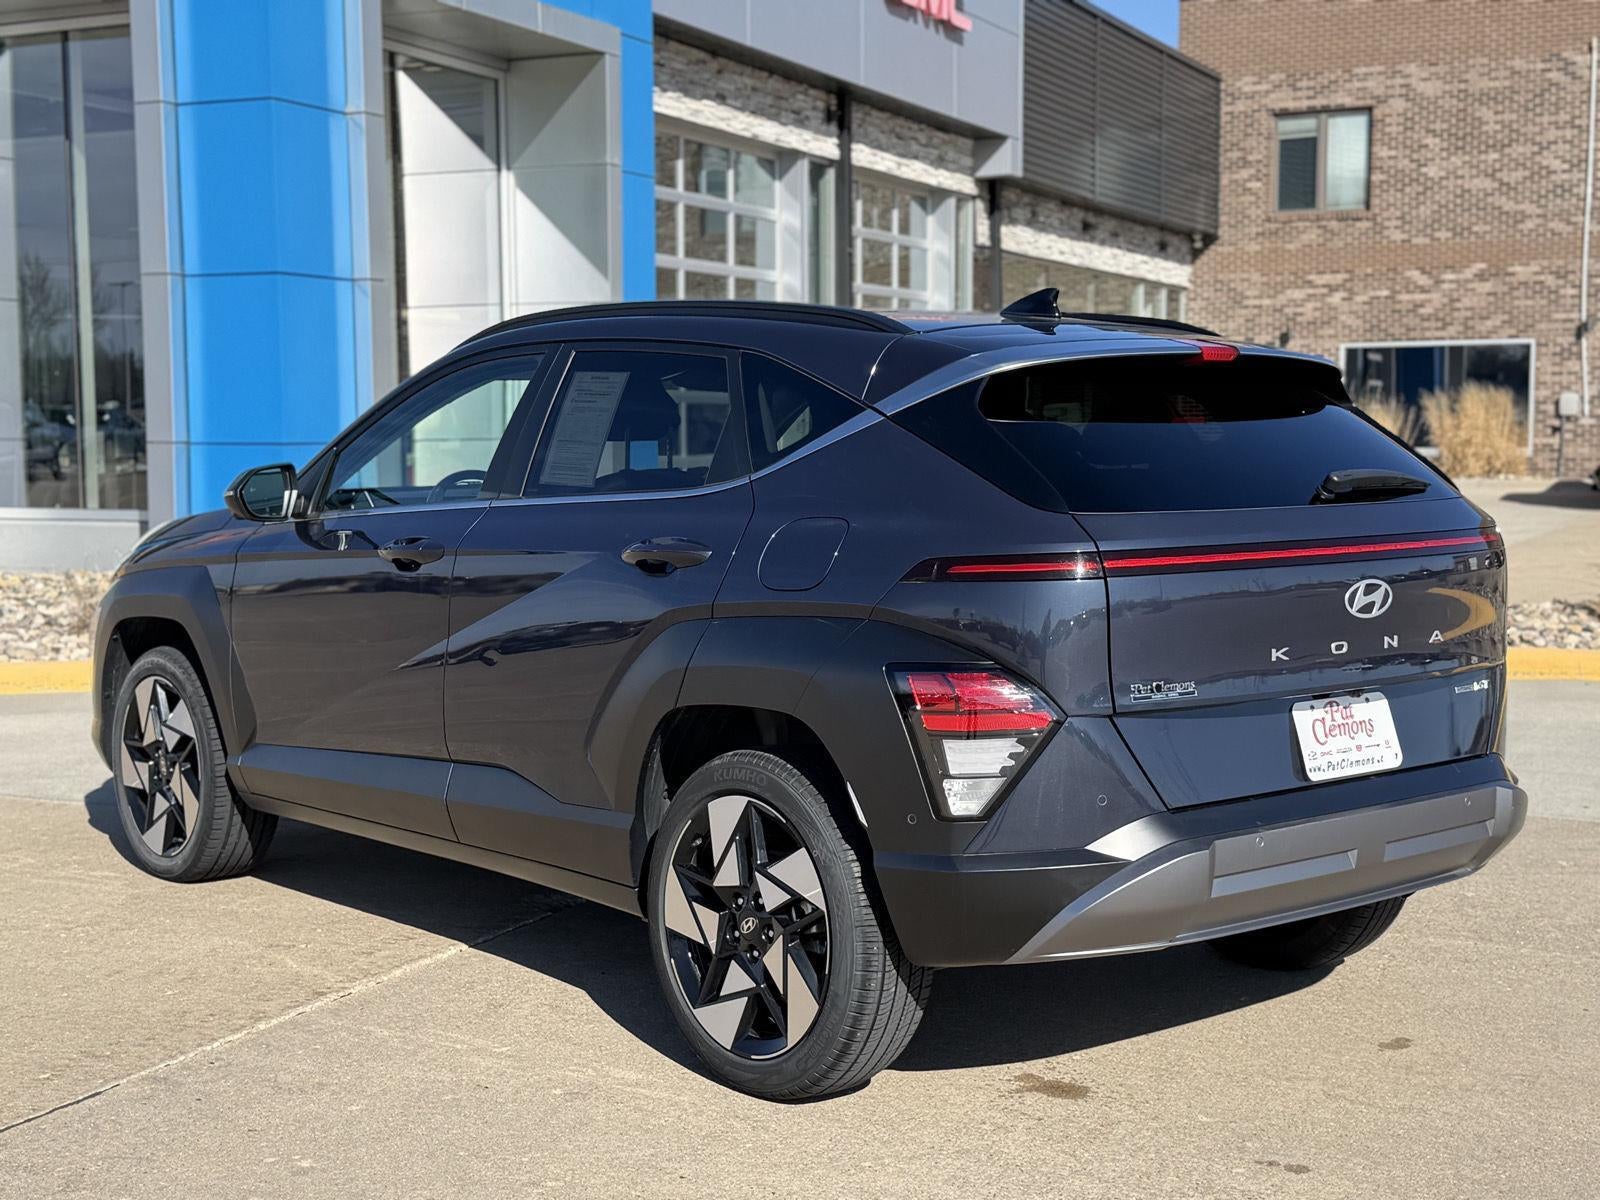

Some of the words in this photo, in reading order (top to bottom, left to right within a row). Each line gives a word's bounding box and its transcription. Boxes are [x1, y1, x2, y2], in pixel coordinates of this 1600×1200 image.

[1271, 630, 1444, 662] KONA
[1131, 683, 1151, 695] Pat
[1152, 681, 1195, 695] Clemons
[1323, 699, 1354, 722] Pat
[1312, 717, 1374, 746] Clemons
[713, 768, 767, 786] KUMHO
